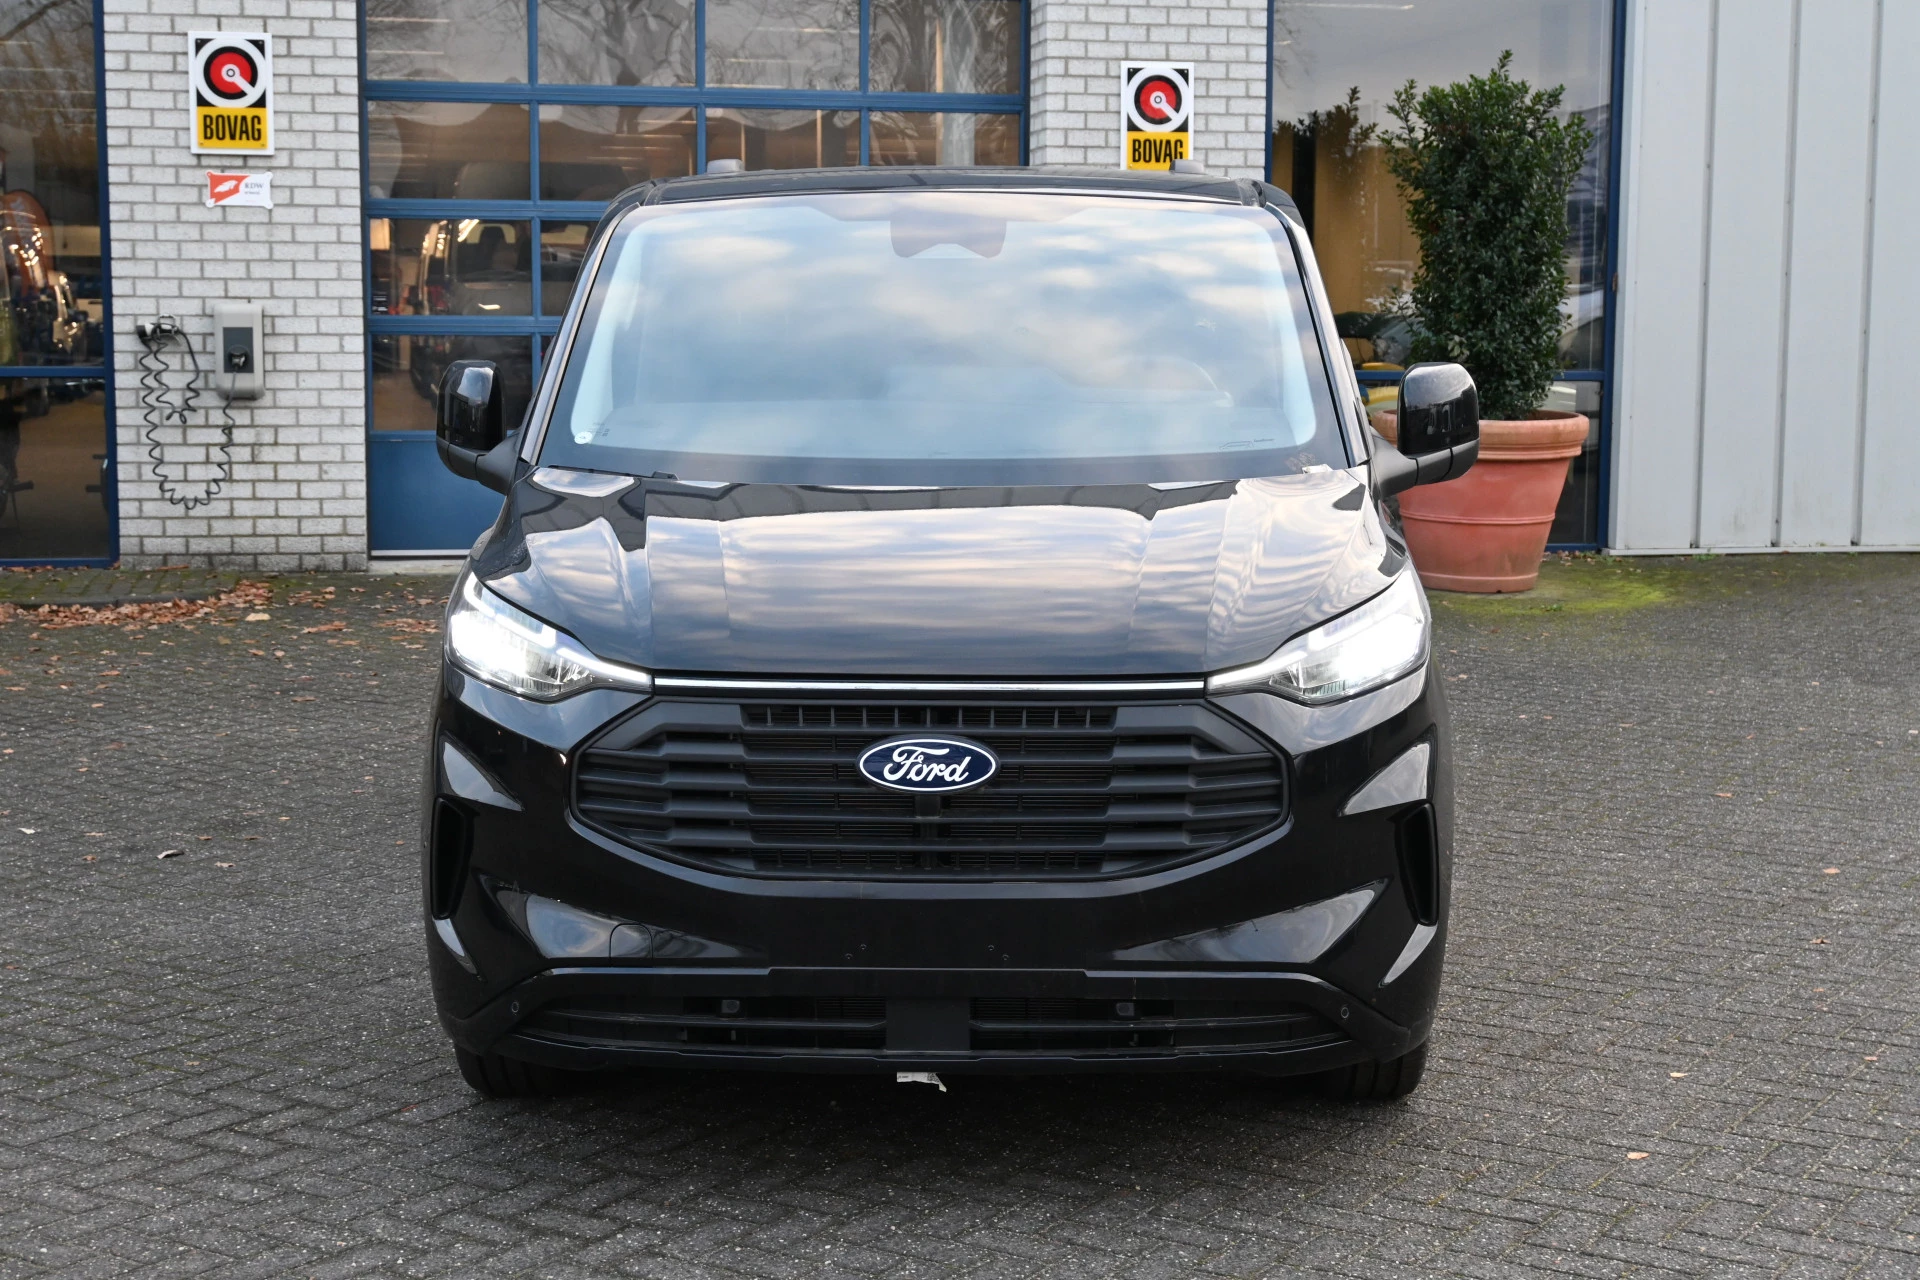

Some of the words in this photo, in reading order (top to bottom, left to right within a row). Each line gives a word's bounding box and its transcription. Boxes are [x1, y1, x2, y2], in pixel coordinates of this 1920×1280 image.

[203, 114, 262, 142] BOVAG
[1132, 138, 1184, 163] BOVAG
[883, 746, 972, 782] Ford
